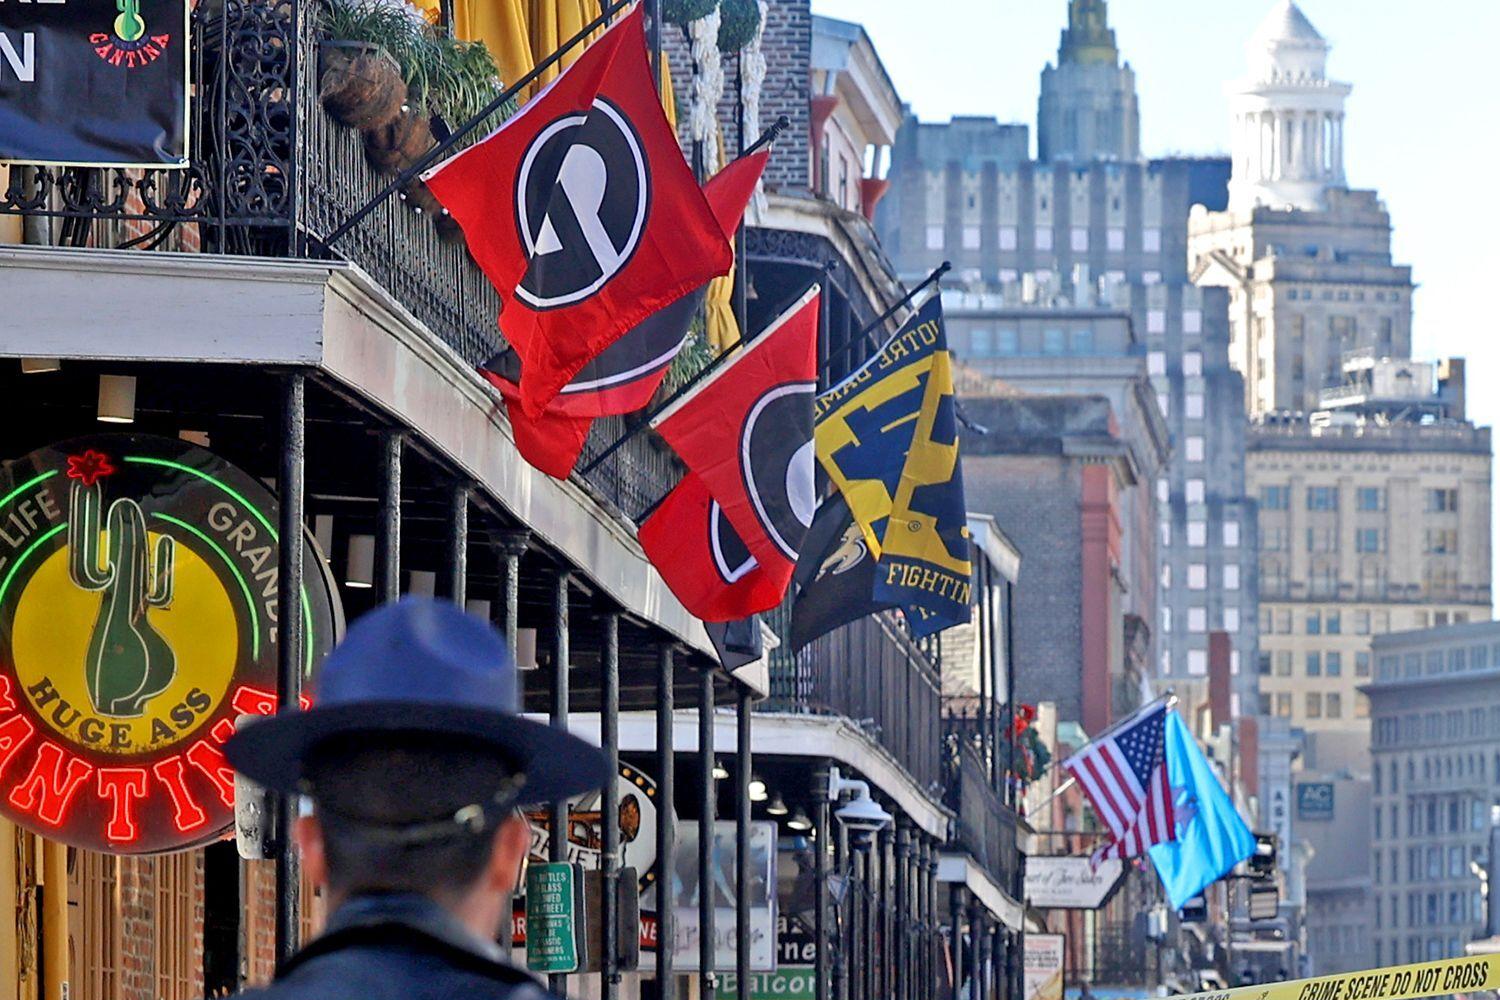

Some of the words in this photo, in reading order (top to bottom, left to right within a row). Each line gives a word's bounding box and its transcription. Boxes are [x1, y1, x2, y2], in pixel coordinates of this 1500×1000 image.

[88, 33, 171, 68] CANTINA
[0, 489, 61, 548] LIFE
[27, 676, 133, 748] HUGE
[149, 687, 211, 743] ASS
[1343, 975, 1389, 1000] SCENE
[1390, 971, 1413, 996] DO
[1412, 967, 1443, 994] NOT
[1442, 961, 1489, 990] CROSS
